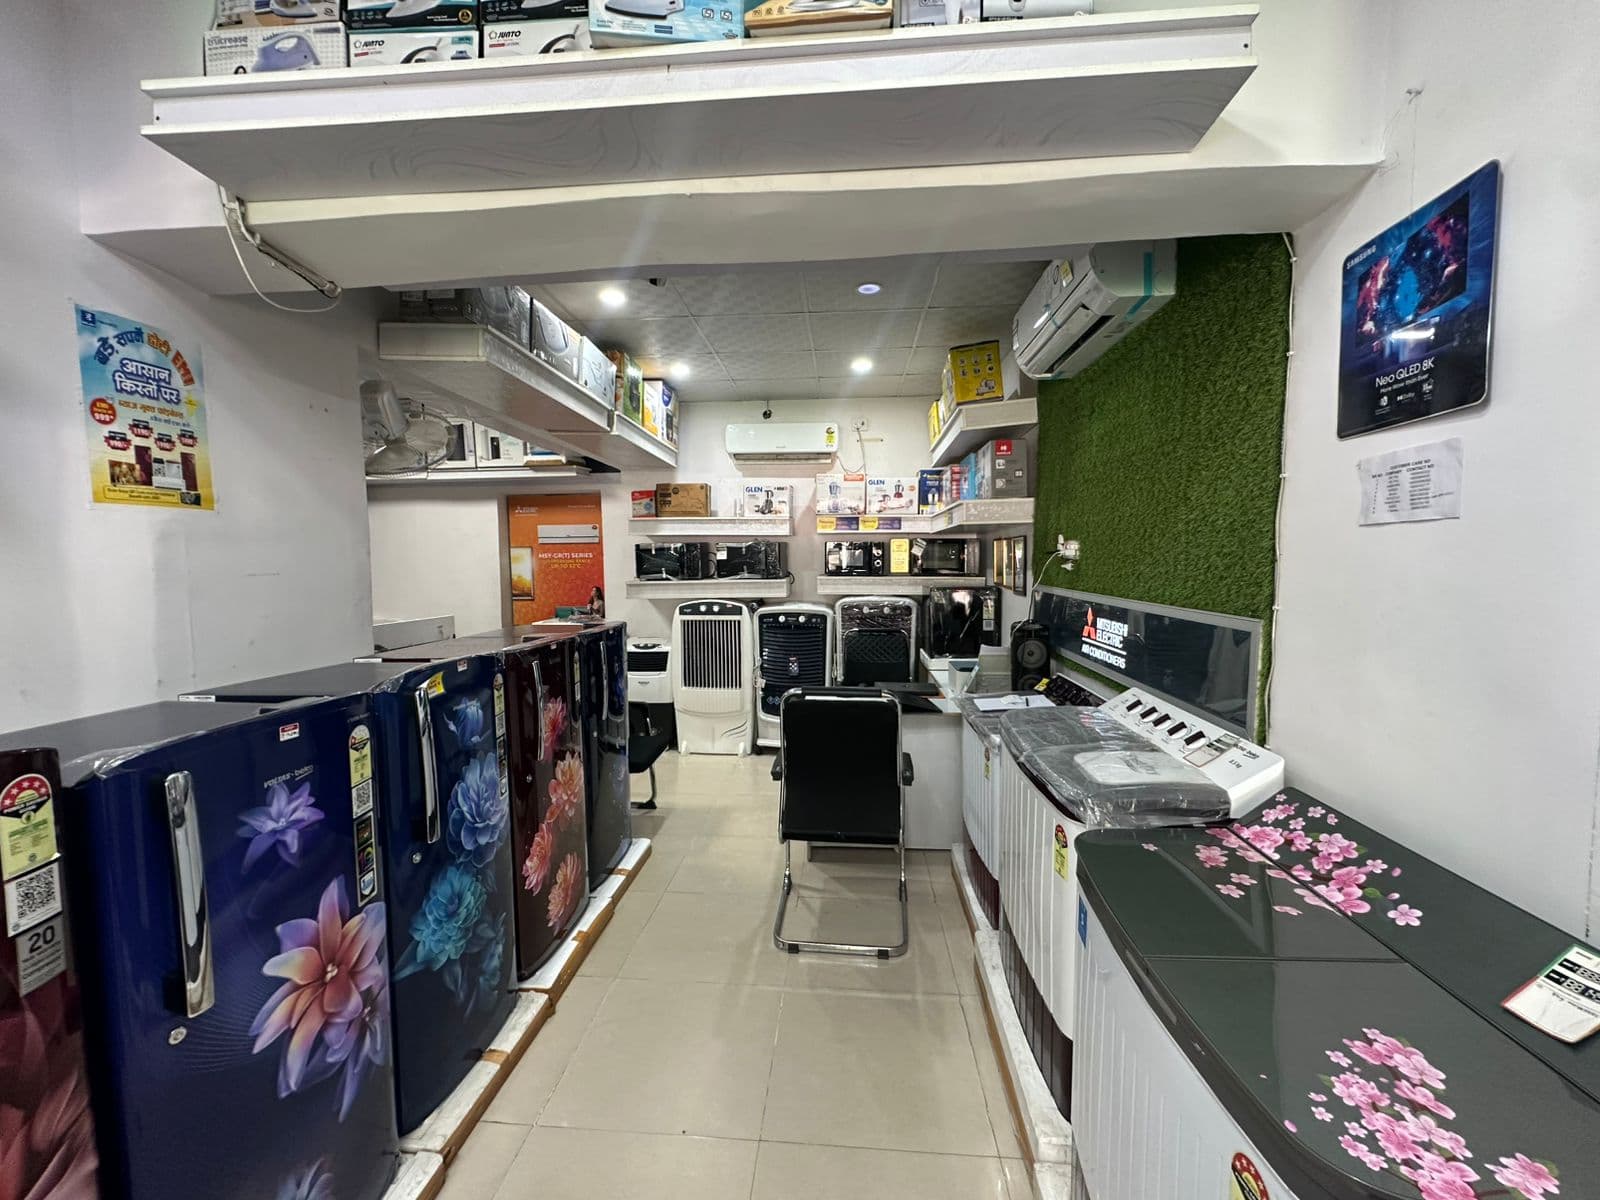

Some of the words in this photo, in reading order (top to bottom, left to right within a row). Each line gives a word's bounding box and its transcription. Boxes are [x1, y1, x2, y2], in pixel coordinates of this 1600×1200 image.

[1346, 244, 1377, 270] SAMSUNG
[121, 358, 171, 384] आसान
[1375, 374, 1395, 388] Neo
[1396, 363, 1421, 380] QLED
[1422, 356, 1435, 371] 8K
[160, 385, 180, 403] पर
[1096, 629, 1124, 649] ELECTRIC
[27, 925, 55, 954] 20
